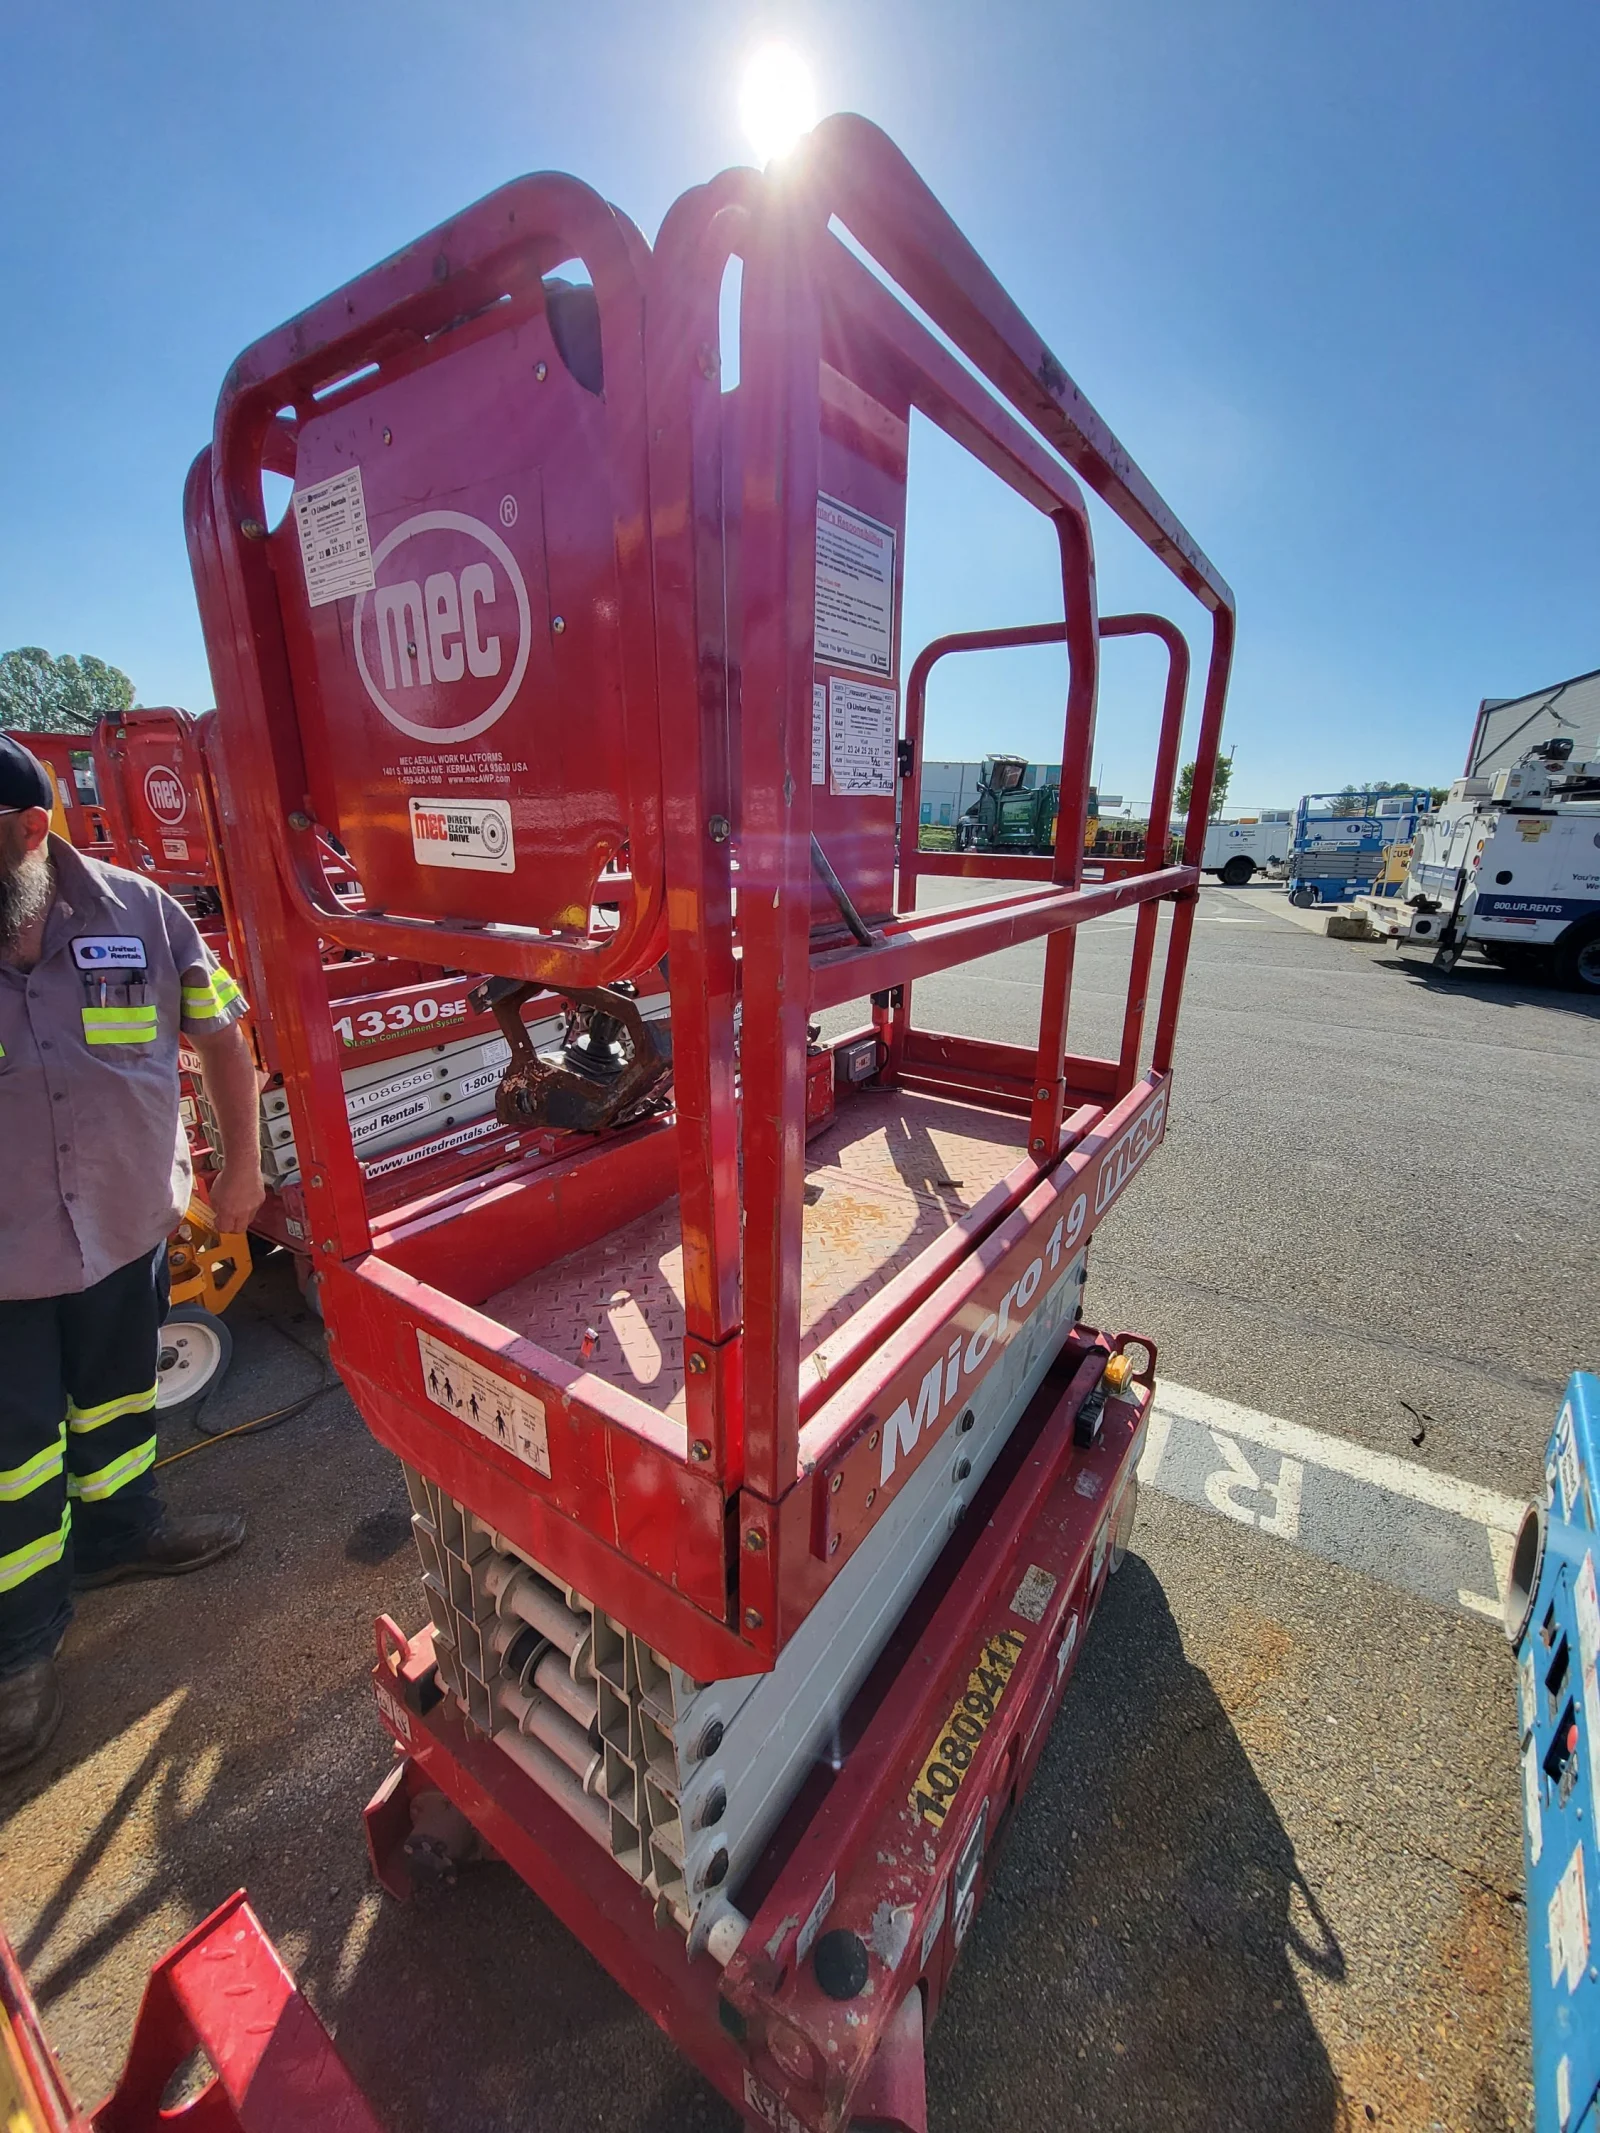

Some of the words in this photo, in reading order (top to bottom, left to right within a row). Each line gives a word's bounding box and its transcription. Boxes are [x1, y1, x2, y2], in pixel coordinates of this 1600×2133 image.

[374, 562, 501, 690] mec
[852, 703, 867, 711] United
[400, 757, 414, 766] MEC
[414, 755, 436, 764] AERIAL
[438, 754, 459, 763] WORK
[460, 752, 503, 763] PLATFORMS
[479, 763, 490, 773] CA
[512, 762, 528, 772] USA
[414, 812, 447, 841] mec
[447, 815, 472, 825] DIRECT
[448, 825, 480, 835] ELECTRIC
[449, 834, 470, 843] DRIVE
[1493, 901, 1562, 913] 800.UR.RENTS
[108, 945, 137, 953] United
[110, 952, 141, 960] Rentals
[354, 1038, 376, 1048] Leak
[380, 1024, 434, 1041] Containment
[436, 1016, 465, 1029] System
[465, 1067, 505, 1092] 1-800-U
[348, 1071, 432, 1109] 11086586
[352, 1119, 377, 1138] ited
[381, 1103, 424, 1127] Rentals
[880, 1257, 1043, 1487] Micro
[1045, 1193, 1088, 1271] 19
[916, 1632, 1025, 1819] 10809411
